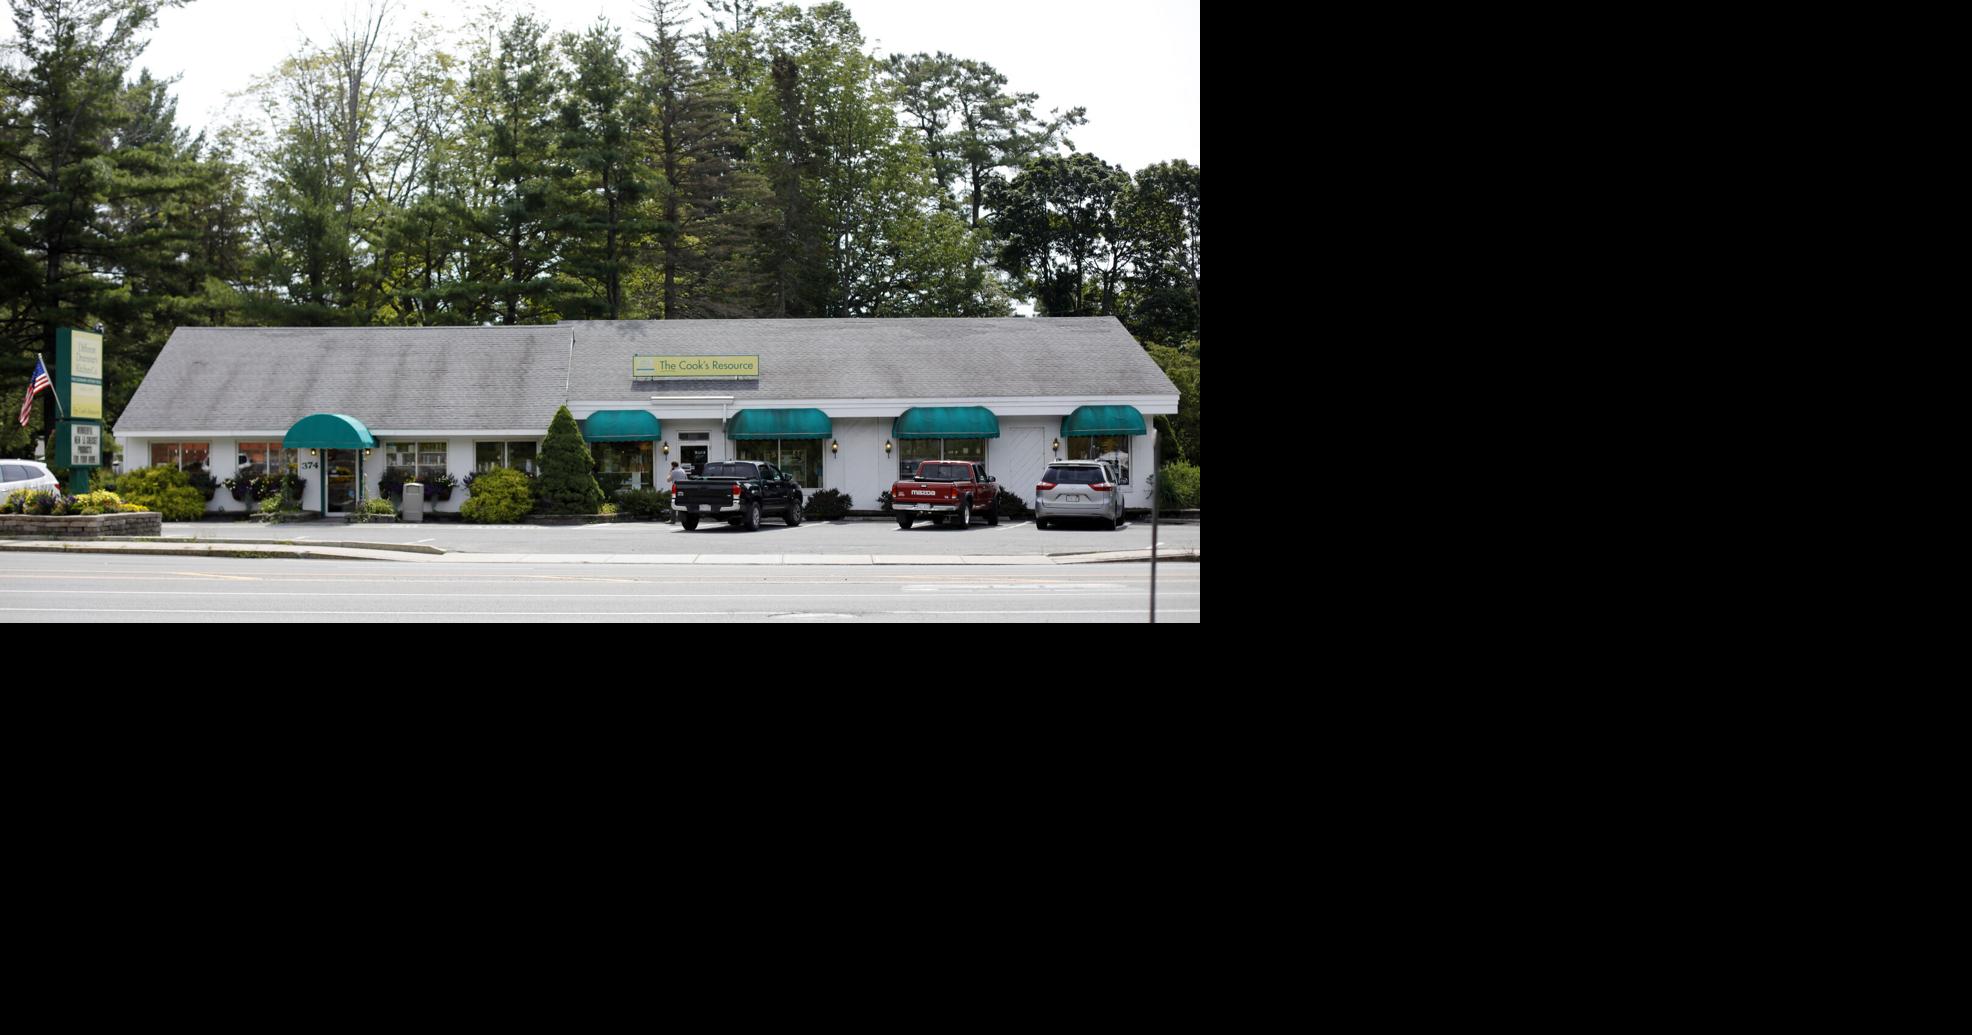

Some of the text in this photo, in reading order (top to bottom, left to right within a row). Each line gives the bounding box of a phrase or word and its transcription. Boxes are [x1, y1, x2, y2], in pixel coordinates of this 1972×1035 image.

[659, 360, 754, 370] The Cook's Resource
[301, 461, 319, 469] 374
